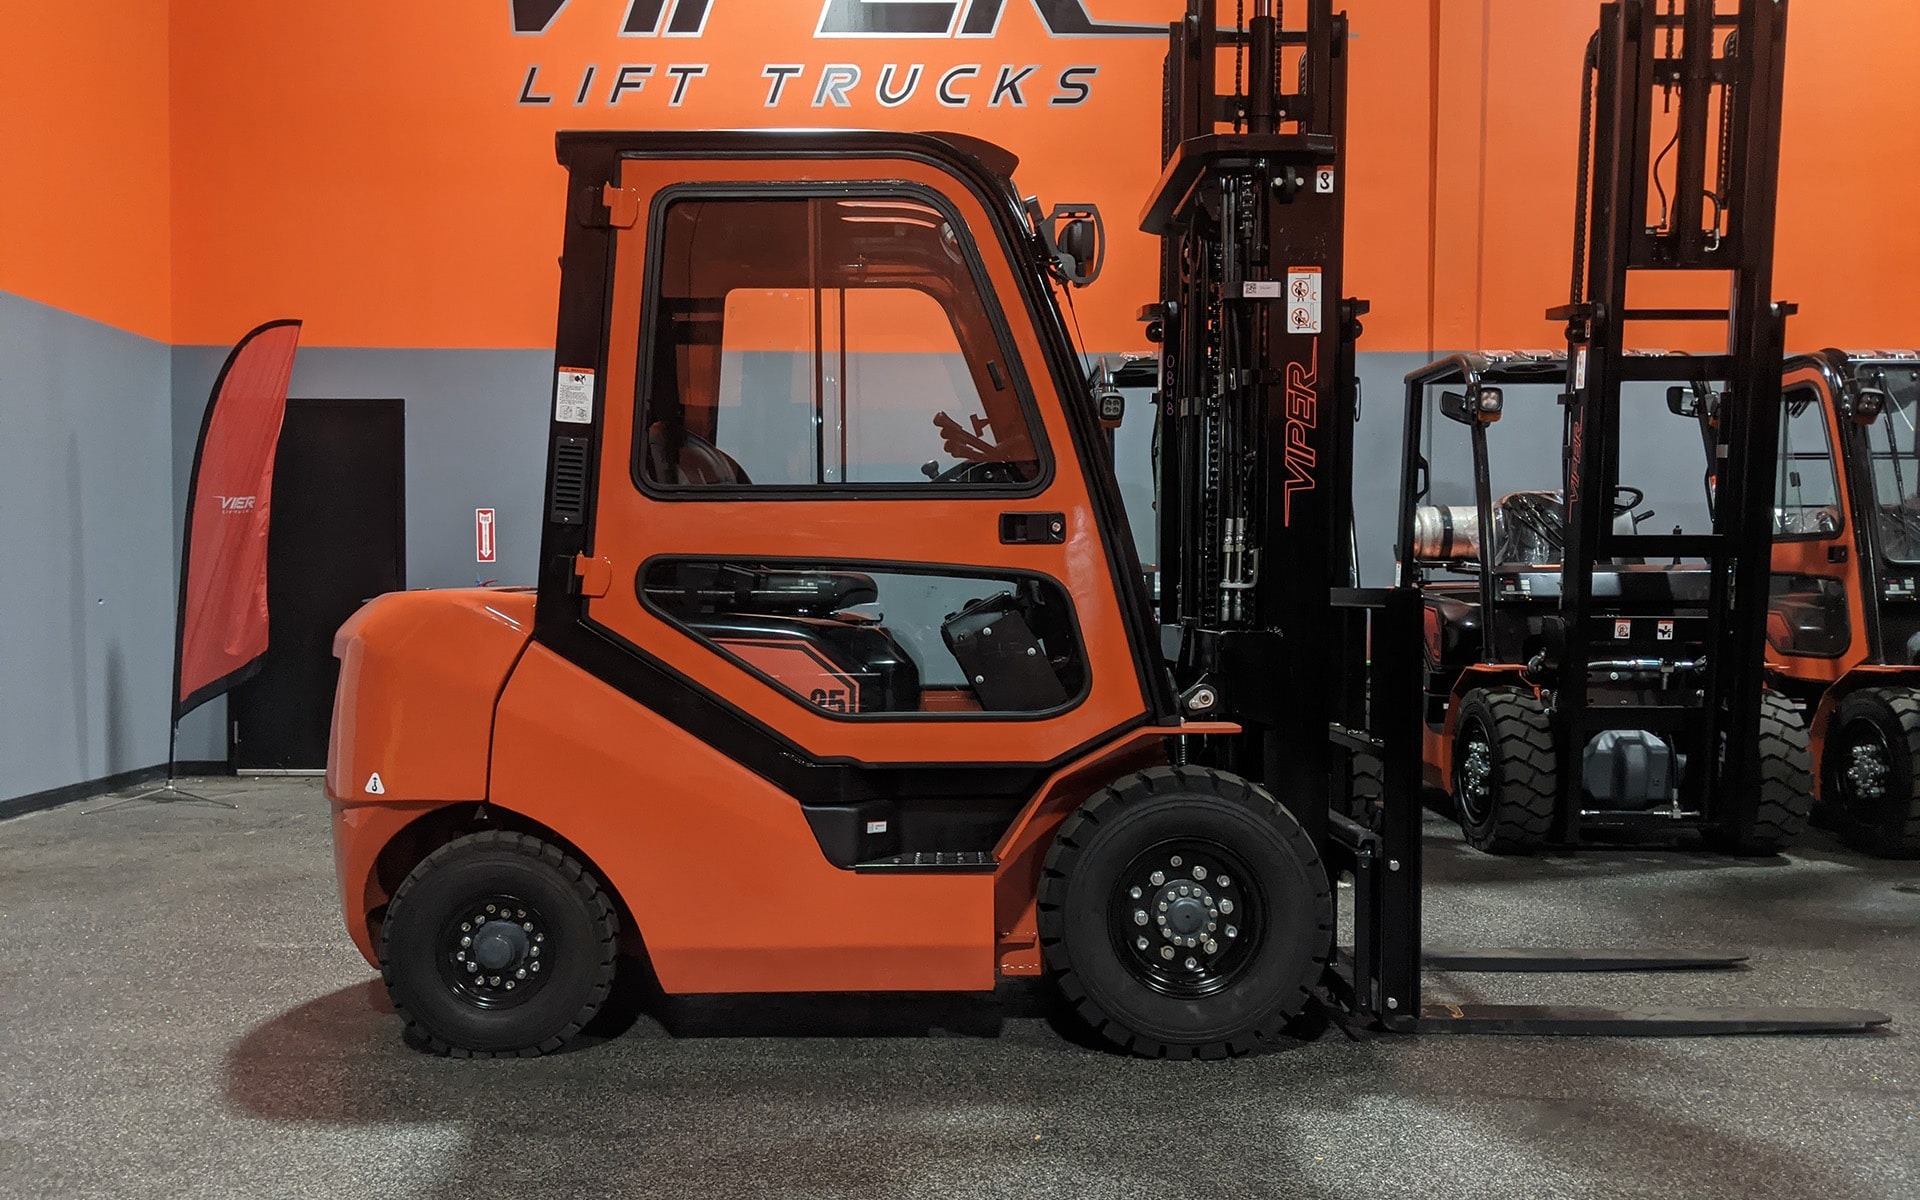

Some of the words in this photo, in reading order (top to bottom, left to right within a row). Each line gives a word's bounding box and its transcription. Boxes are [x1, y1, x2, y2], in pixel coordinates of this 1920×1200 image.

[516, 64, 709, 107] LIFT
[761, 64, 1101, 107] TRUCKS
[1284, 336, 1318, 527] VIPER
